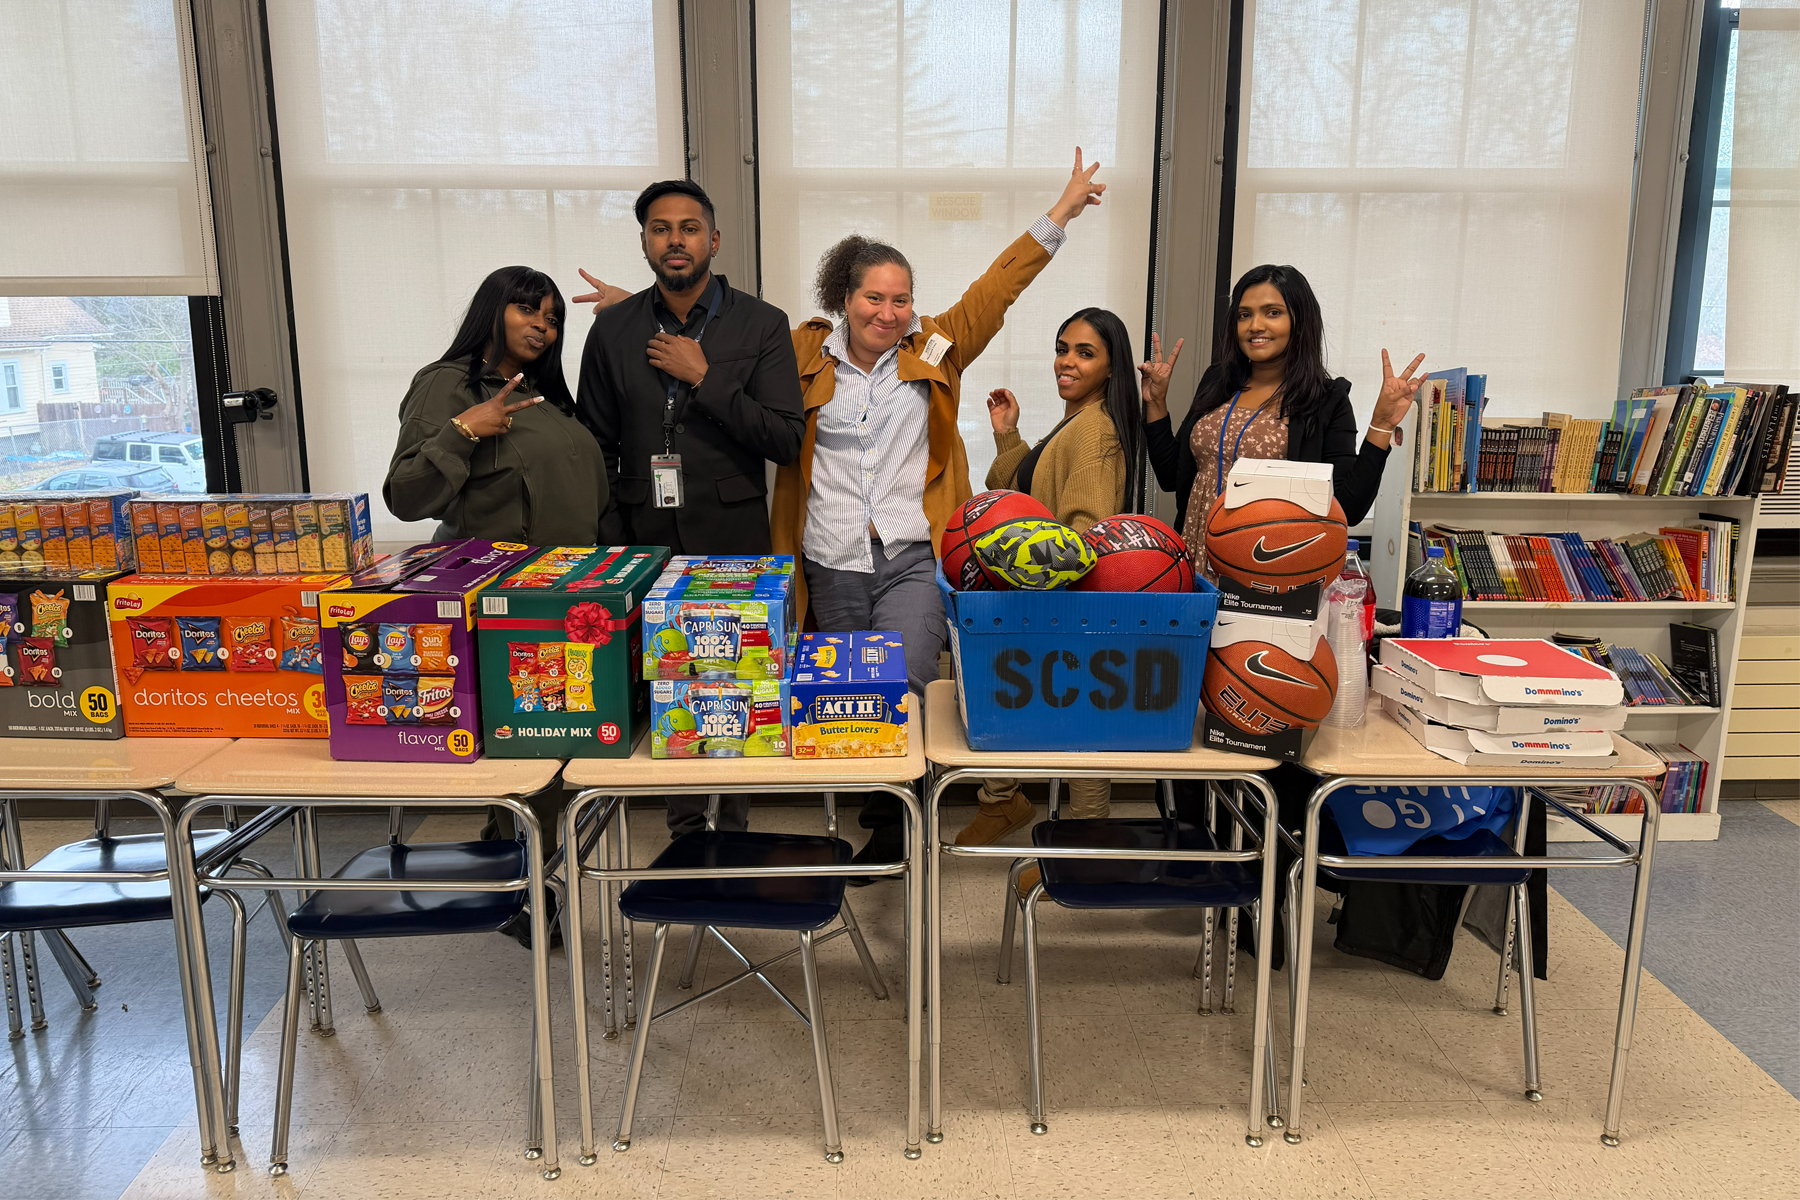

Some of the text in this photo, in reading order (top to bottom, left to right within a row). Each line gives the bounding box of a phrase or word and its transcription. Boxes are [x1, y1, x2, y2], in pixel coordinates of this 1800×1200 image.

[937, 196, 976, 206] RESCUE
[932, 208, 980, 218] WINDOW
[1675, 398, 1704, 470] THE BIG BUG BOOK
[1762, 416, 1778, 458] PLANETS
[37, 603, 62, 616] Cheetos
[1240, 600, 1283, 612] Tournament
[136, 630, 166, 638] Doritos
[184, 630, 215, 638] Doritos
[234, 623, 265, 641] Cheetos
[290, 626, 316, 640] Cheetos
[422, 636, 441, 647] Sun
[695, 636, 730, 645] 100%
[539, 646, 560, 659] Cheetos
[689, 645, 734, 658] JUICE
[1401, 660, 1418, 675] Domino's
[516, 678, 535, 690] Cheetos
[540, 680, 561, 689] Cheetos
[994, 648, 1180, 712] SCSD
[350, 680, 378, 698] Cheetos
[1400, 688, 1423, 703] Domino's
[1525, 688, 1582, 697] Dommmino's
[28, 690, 76, 708] bold
[88, 693, 108, 711] 50
[134, 688, 298, 706] doritos cheetos
[418, 688, 451, 706] Fritos
[823, 700, 874, 714] ACT II
[1218, 684, 1292, 734] ELITE
[703, 715, 739, 724] 100%
[518, 728, 592, 737] HOLIDAY MIX
[601, 726, 616, 736] 50
[696, 724, 742, 736] JUICE
[820, 724, 879, 735] Butter Lovers
[1210, 729, 1225, 737] Nike
[398, 731, 444, 745] flavor
[454, 734, 468, 747] 50
[1209, 735, 1267, 751] Elite Tournament
[1512, 741, 1570, 750] Dommmino's
[1363, 798, 1432, 830] GO
